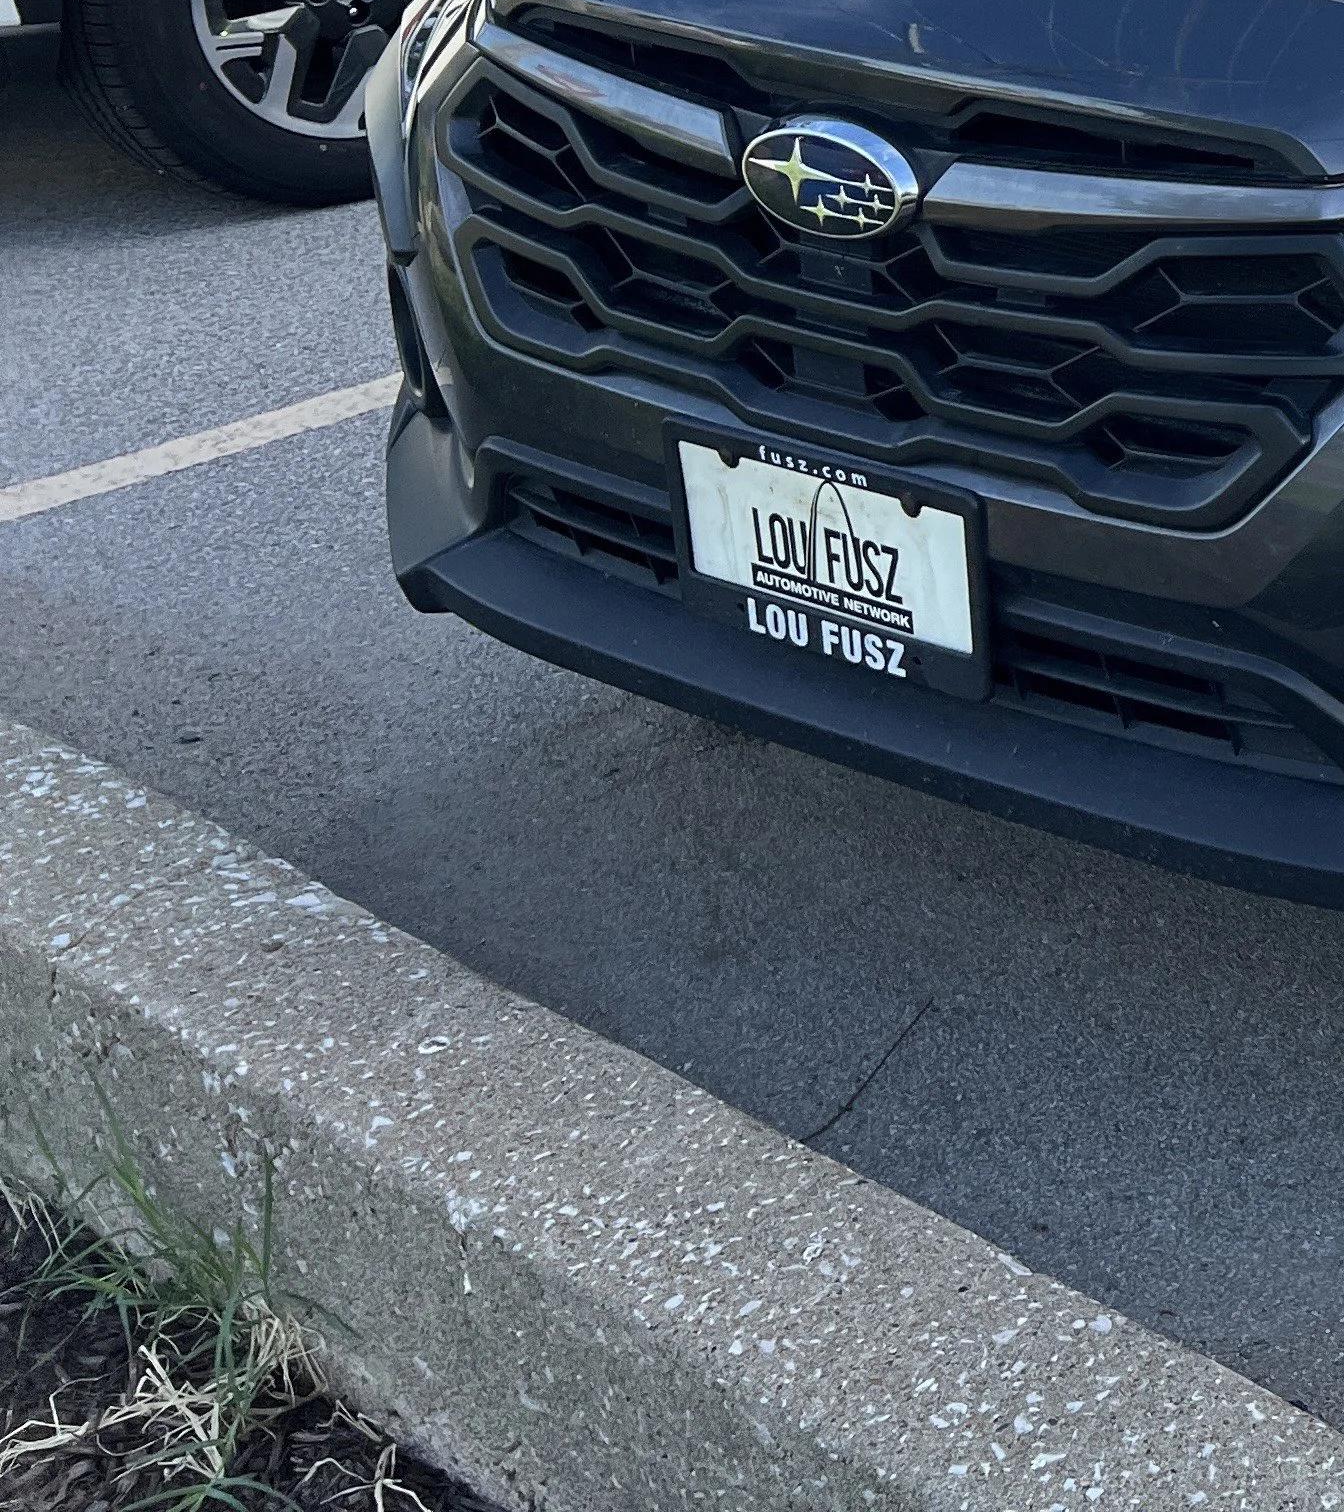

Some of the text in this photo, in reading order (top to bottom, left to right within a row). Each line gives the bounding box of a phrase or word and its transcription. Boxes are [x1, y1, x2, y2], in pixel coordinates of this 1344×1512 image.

[758, 444, 868, 488] fusz.com
[751, 506, 903, 605] LOU FUSZ
[756, 570, 912, 629] AUTOMOTIVE NETWORK
[746, 597, 907, 678] LOU FUSZ
